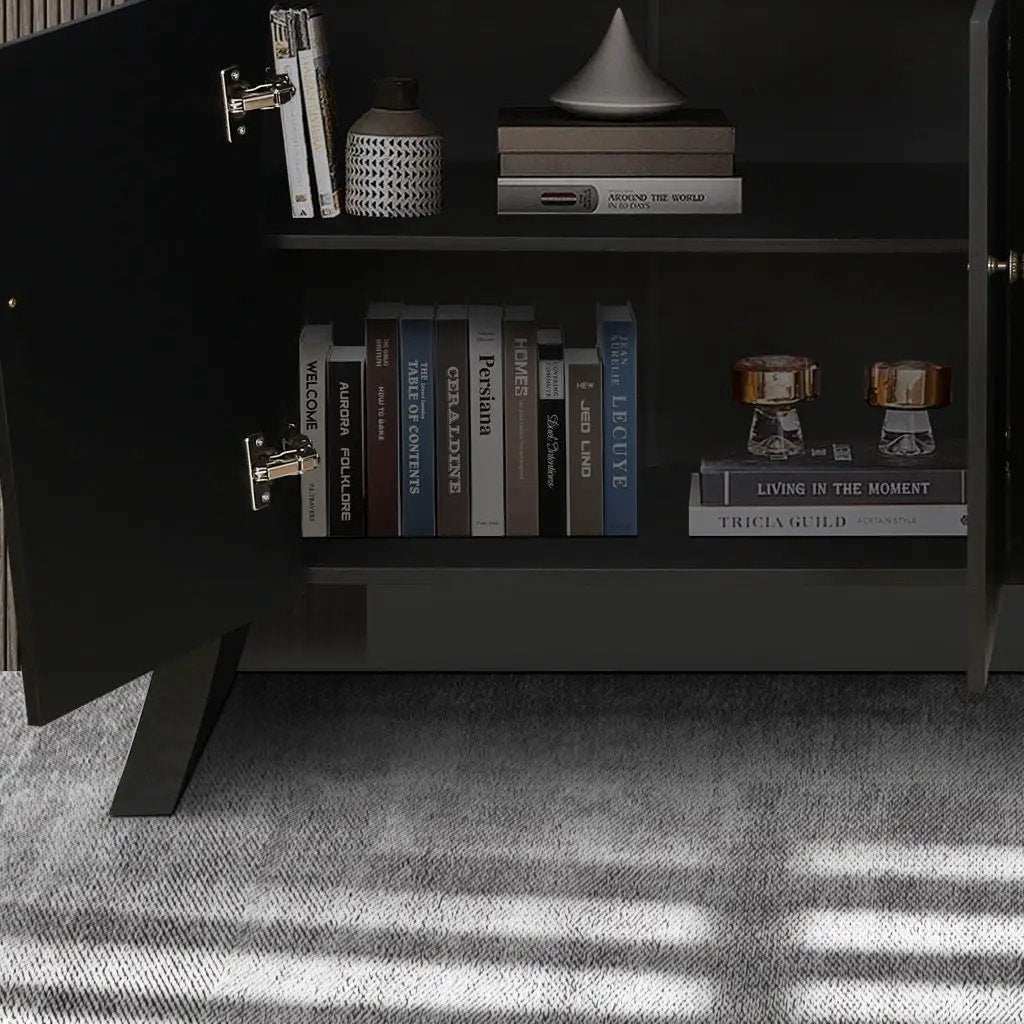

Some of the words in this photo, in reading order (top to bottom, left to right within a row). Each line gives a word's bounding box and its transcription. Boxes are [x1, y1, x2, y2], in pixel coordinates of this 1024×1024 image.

[608, 193, 648, 203] AROUND
[650, 193, 669, 203] THE
[670, 193, 706, 203] WORLD
[408, 360, 419, 400] TABLE
[421, 361, 429, 381] THE
[514, 337, 528, 397] HOMES
[305, 360, 318, 431] WELCOME
[339, 381, 350, 437] AURORA
[408, 404, 419, 422] OF
[479, 355, 495, 436] Persiana
[580, 400, 591, 434] JED
[408, 425, 420, 495] CONTENTS
[580, 440, 591, 478] LIND
[612, 395, 628, 489] LECUYE
[340, 447, 351, 522] FOLKLORE
[757, 481, 806, 496] LIVING
[812, 482, 827, 496] IN
[833, 482, 862, 495] THE
[868, 482, 931, 495] MOMENT
[718, 516, 783, 529] TRICIA
[789, 516, 847, 528] GUILD
